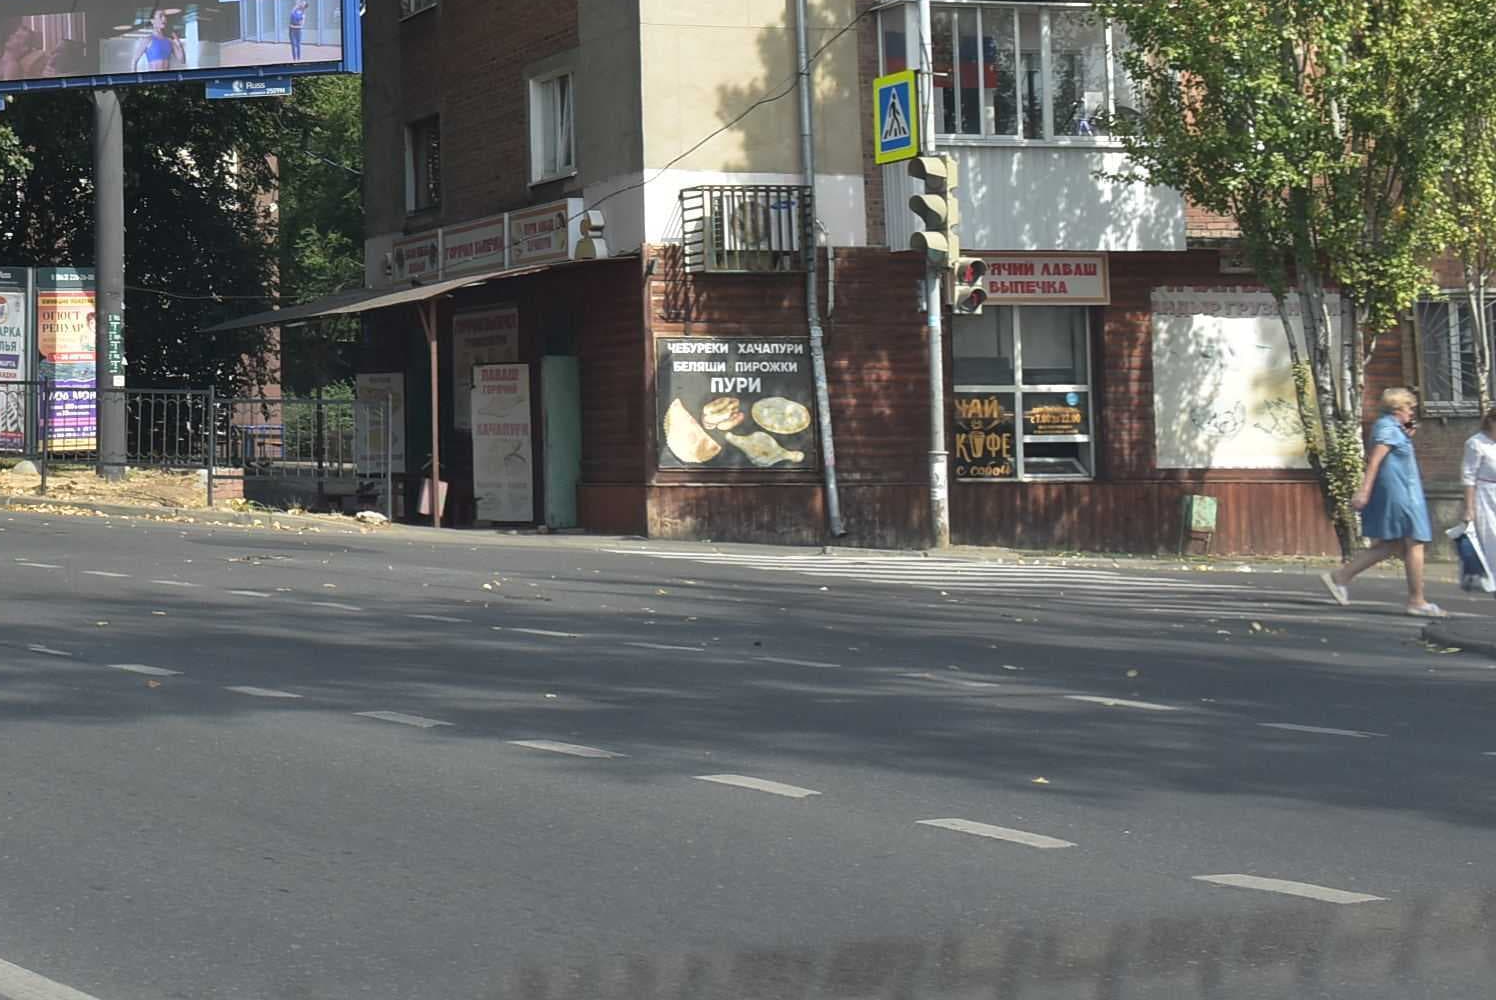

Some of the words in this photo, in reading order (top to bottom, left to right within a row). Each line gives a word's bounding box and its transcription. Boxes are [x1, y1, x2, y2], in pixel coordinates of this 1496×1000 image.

[1041, 263, 1097, 276] ЛАВАШ
[989, 280, 1068, 294] ВЫПЕЧКА
[667, 342, 729, 354] ЧЕБУРЕКИ
[737, 343, 804, 355] ХАЧАПУРИ
[673, 361, 726, 372] БЕЛЯШИ
[735, 361, 798, 373] ПИРОЖКИ
[710, 377, 762, 393] ПУРИ
[955, 395, 1000, 418] ЧАЙ
[970, 461, 1012, 476] собой
